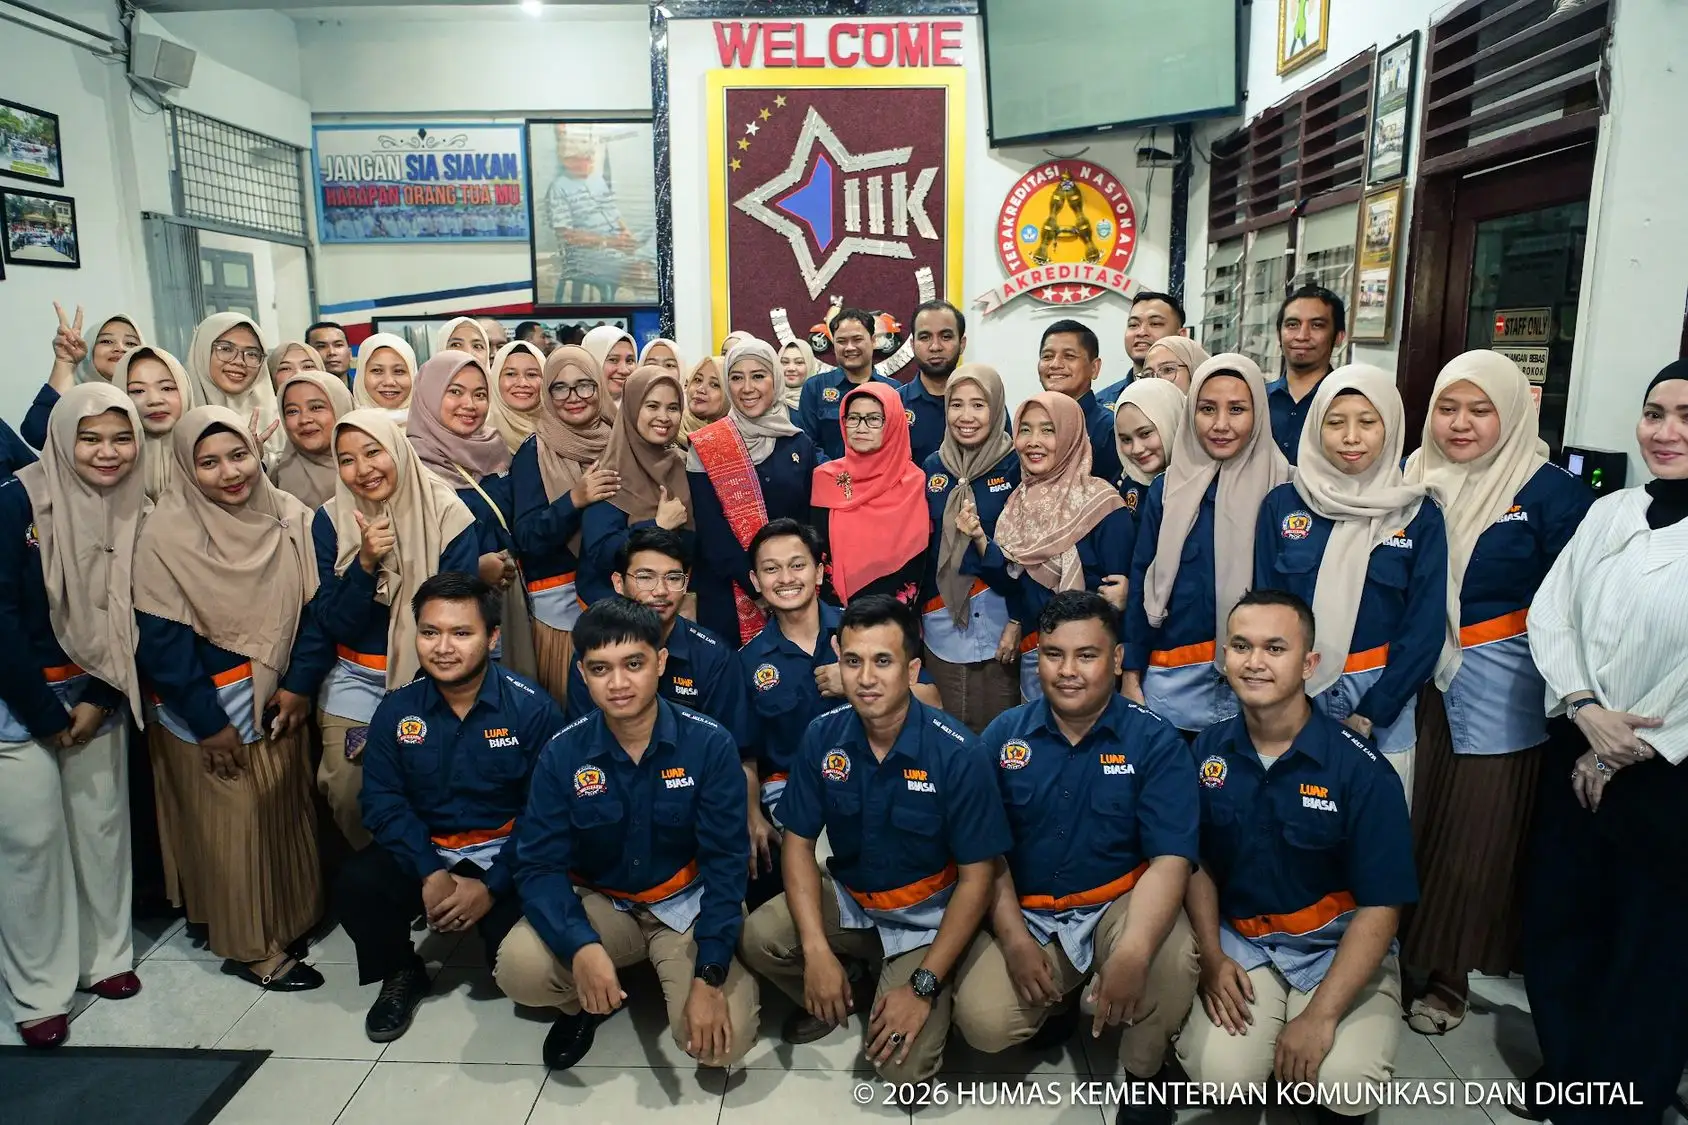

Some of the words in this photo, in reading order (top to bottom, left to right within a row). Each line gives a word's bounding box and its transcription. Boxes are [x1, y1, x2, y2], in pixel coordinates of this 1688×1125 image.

[713, 22, 963, 68] WELCOME
[325, 155, 401, 182] JANGAN
[406, 153, 440, 181] SIA
[442, 153, 518, 180] SIAKAN
[325, 185, 400, 206] HARAPAN
[403, 184, 456, 205] ORANG
[459, 184, 491, 205] TUA
[494, 183, 521, 206] MU
[1002, 165, 1060, 271] TERAKREDITASI
[1079, 166, 1132, 257] NASIONAL
[1002, 265, 1131, 298] AKREDITASI
[1504, 317, 1527, 336] STAFF
[1527, 316, 1547, 336] ONLY
[1529, 353, 1546, 363] BEBAS
[990, 482, 1012, 493] BIASA
[673, 676, 694, 688] LUAR
[675, 685, 699, 697] BIASA
[484, 728, 509, 739] LUAR
[489, 736, 520, 749] BIASA
[1100, 753, 1126, 764] LUAR
[661, 767, 686, 780] LUAR
[903, 768, 928, 781] LUAR
[1103, 763, 1135, 775] BIASA
[665, 777, 695, 790] BIASA
[907, 780, 937, 793] BIASA
[1299, 783, 1329, 799] LUAR
[1302, 796, 1338, 813] BIASA
